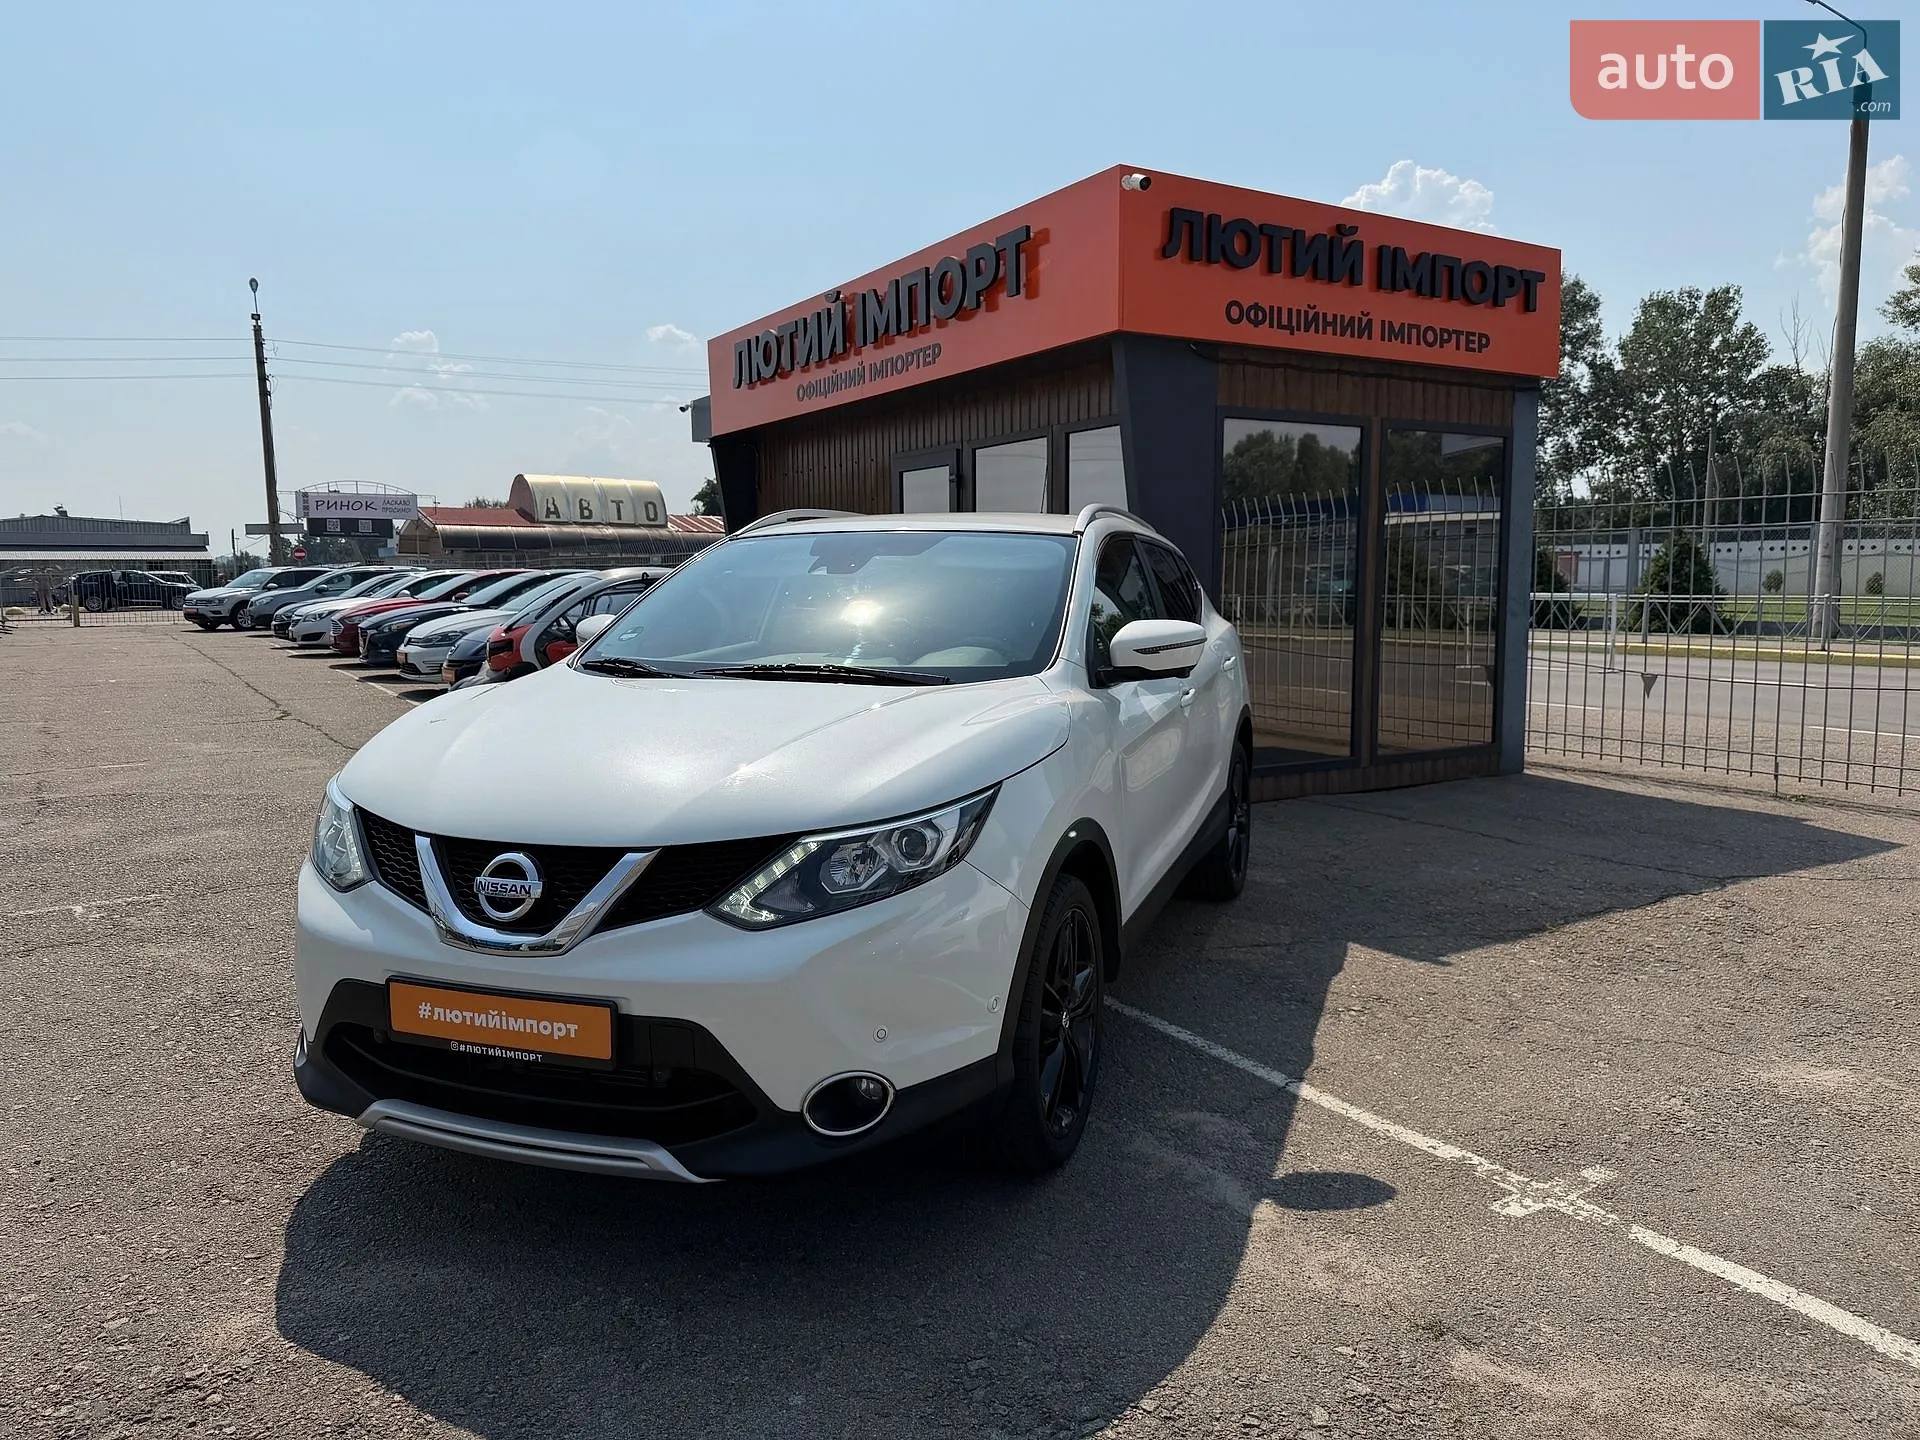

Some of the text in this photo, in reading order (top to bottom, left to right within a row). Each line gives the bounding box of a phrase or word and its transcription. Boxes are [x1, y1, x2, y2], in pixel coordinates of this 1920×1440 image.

[1162, 207, 1546, 313] ЛЮТИЙ ІМПОРТ
[732, 225, 1032, 390] ЛЮТИЙ ІМПОРТ
[1225, 299, 1491, 354] ОФІЦІЙНИЙ ІМПОРТЕР
[796, 342, 943, 403] ОФІЦІЙНИЙ ІМПОРТЕР
[315, 500, 377, 511] РИНОК
[545, 497, 658, 522] АВТО
[477, 880, 532, 895] NISSAN
[418, 1002, 578, 1039] #лютийімпорт
